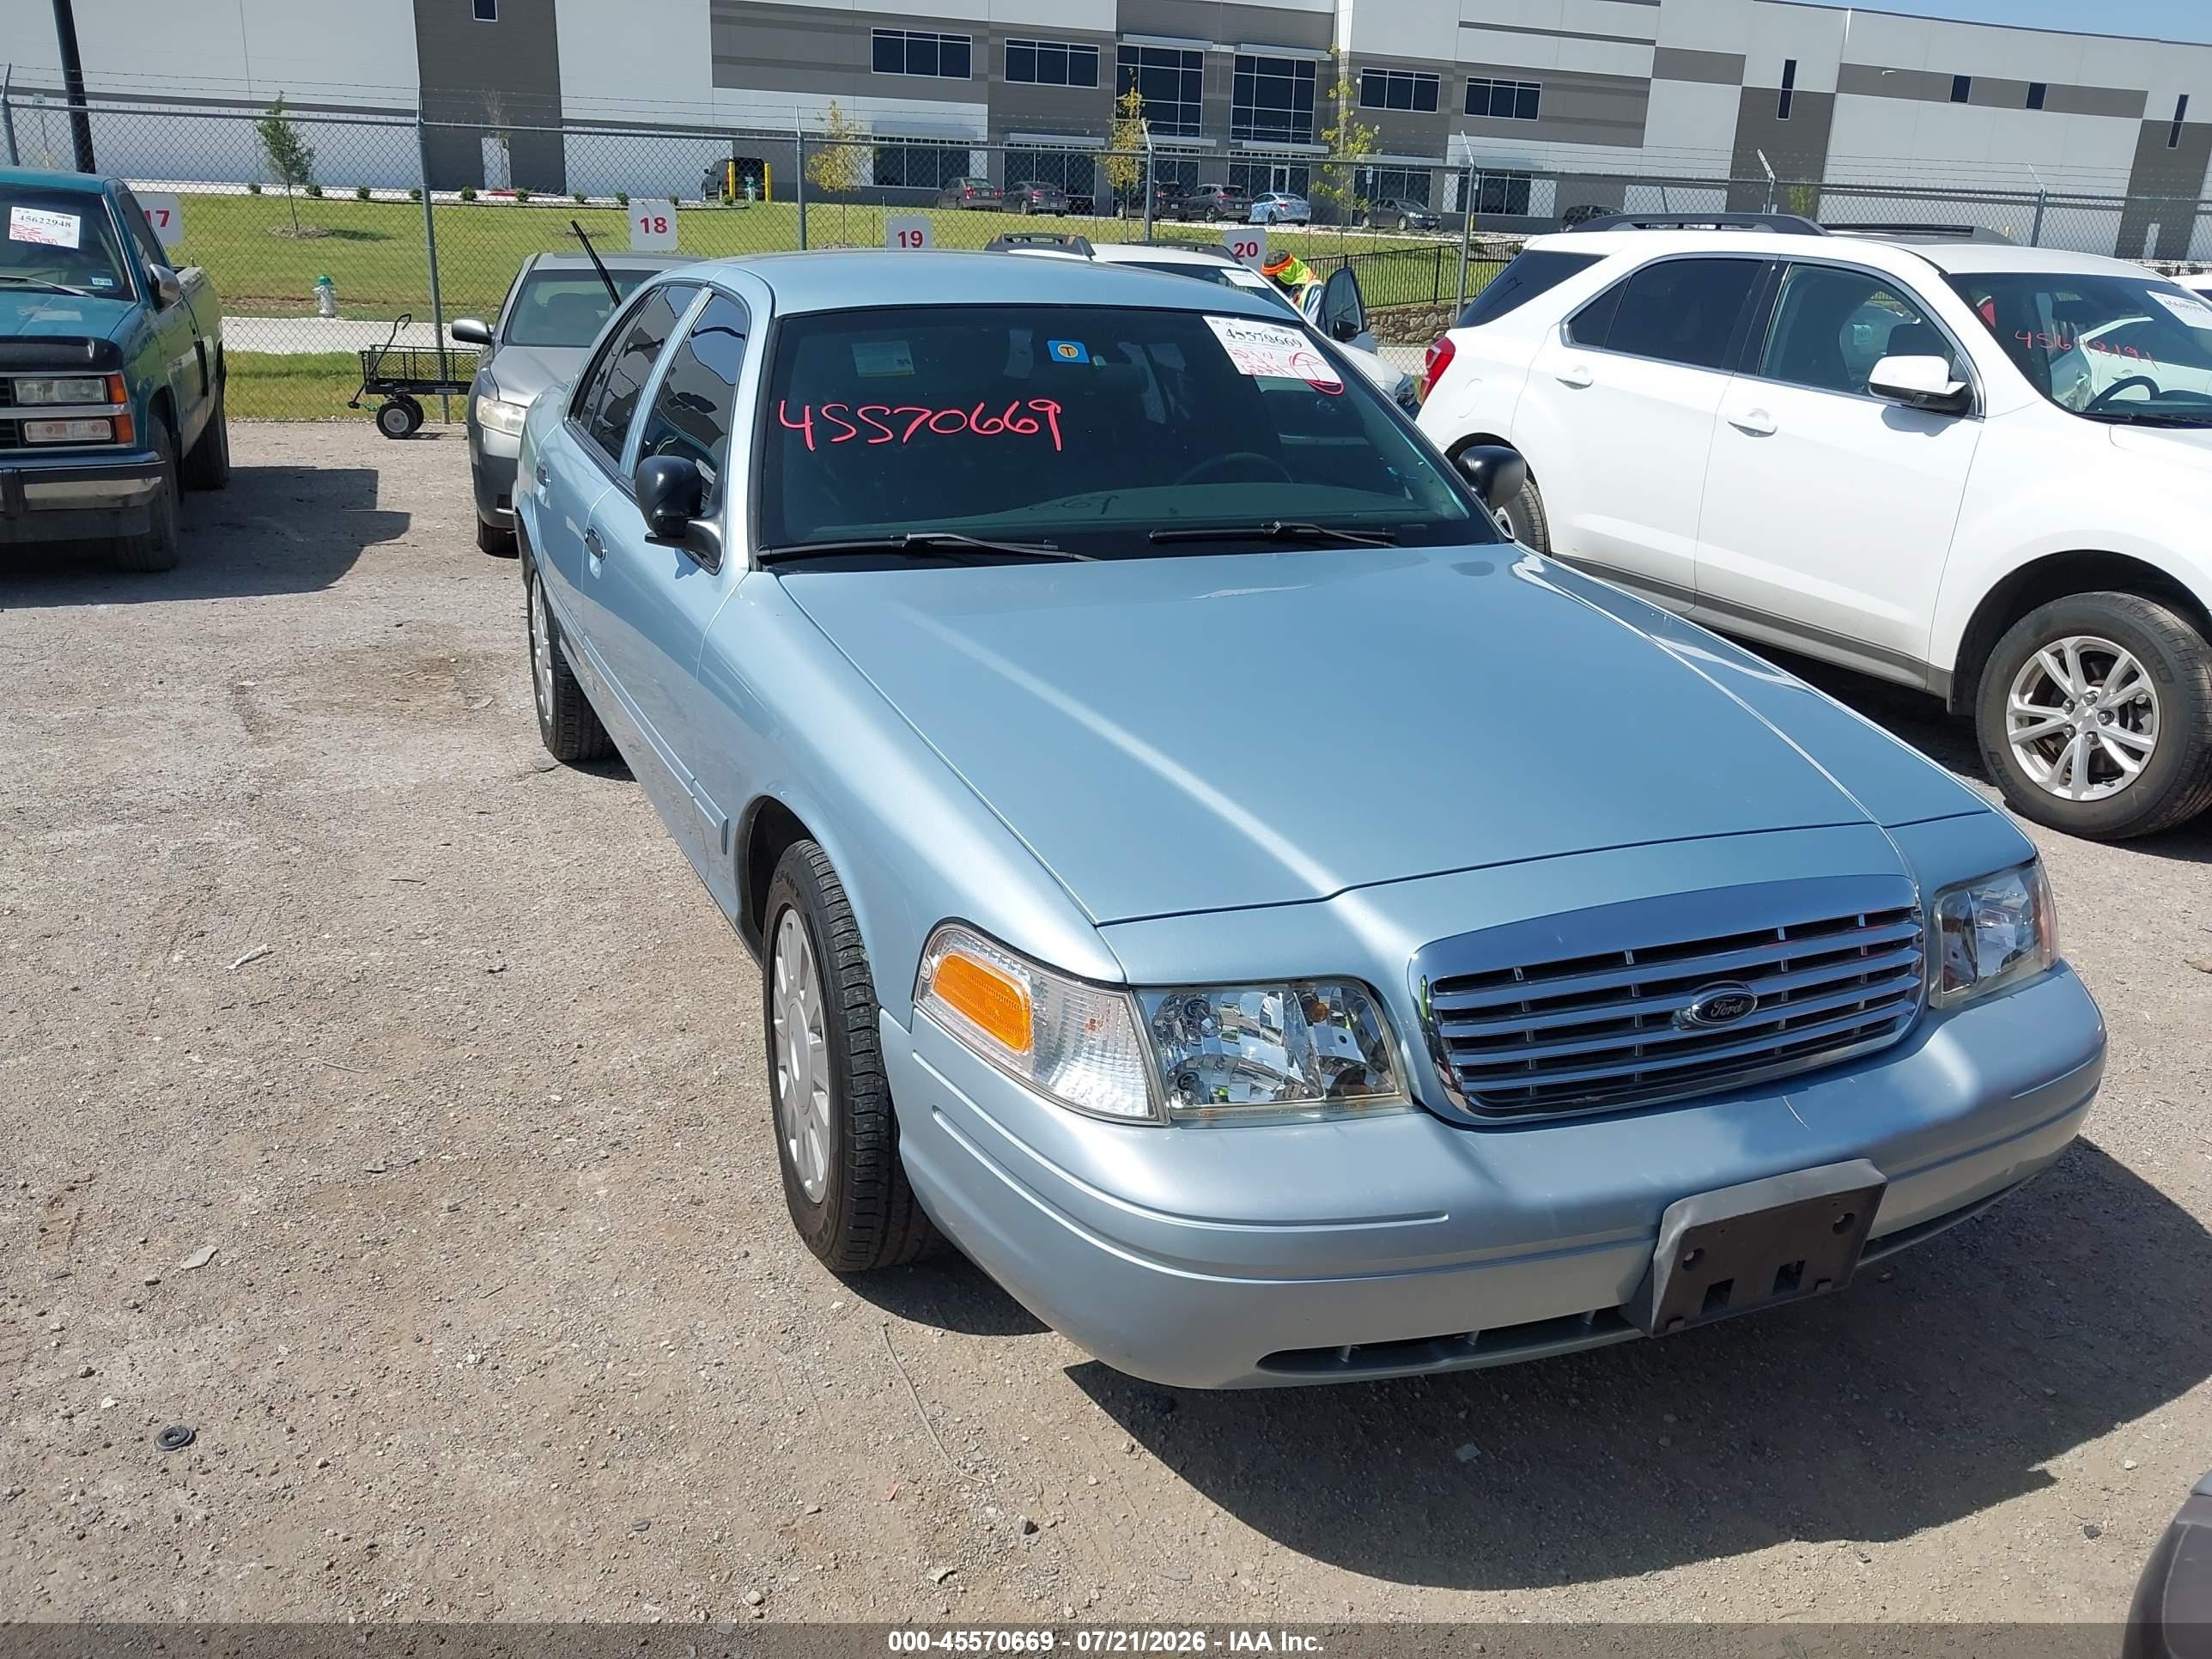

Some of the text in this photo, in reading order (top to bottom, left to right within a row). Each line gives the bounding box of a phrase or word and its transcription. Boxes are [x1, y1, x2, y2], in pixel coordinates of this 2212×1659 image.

[18, 215, 72, 228] 45622948
[640, 216, 668, 234] 18
[897, 230, 923, 248] 19
[1233, 241, 1259, 258] 20
[1225, 328, 1303, 349] 45570669
[778, 398, 1062, 453] 45570669
[1710, 997, 1745, 1018] Ford
